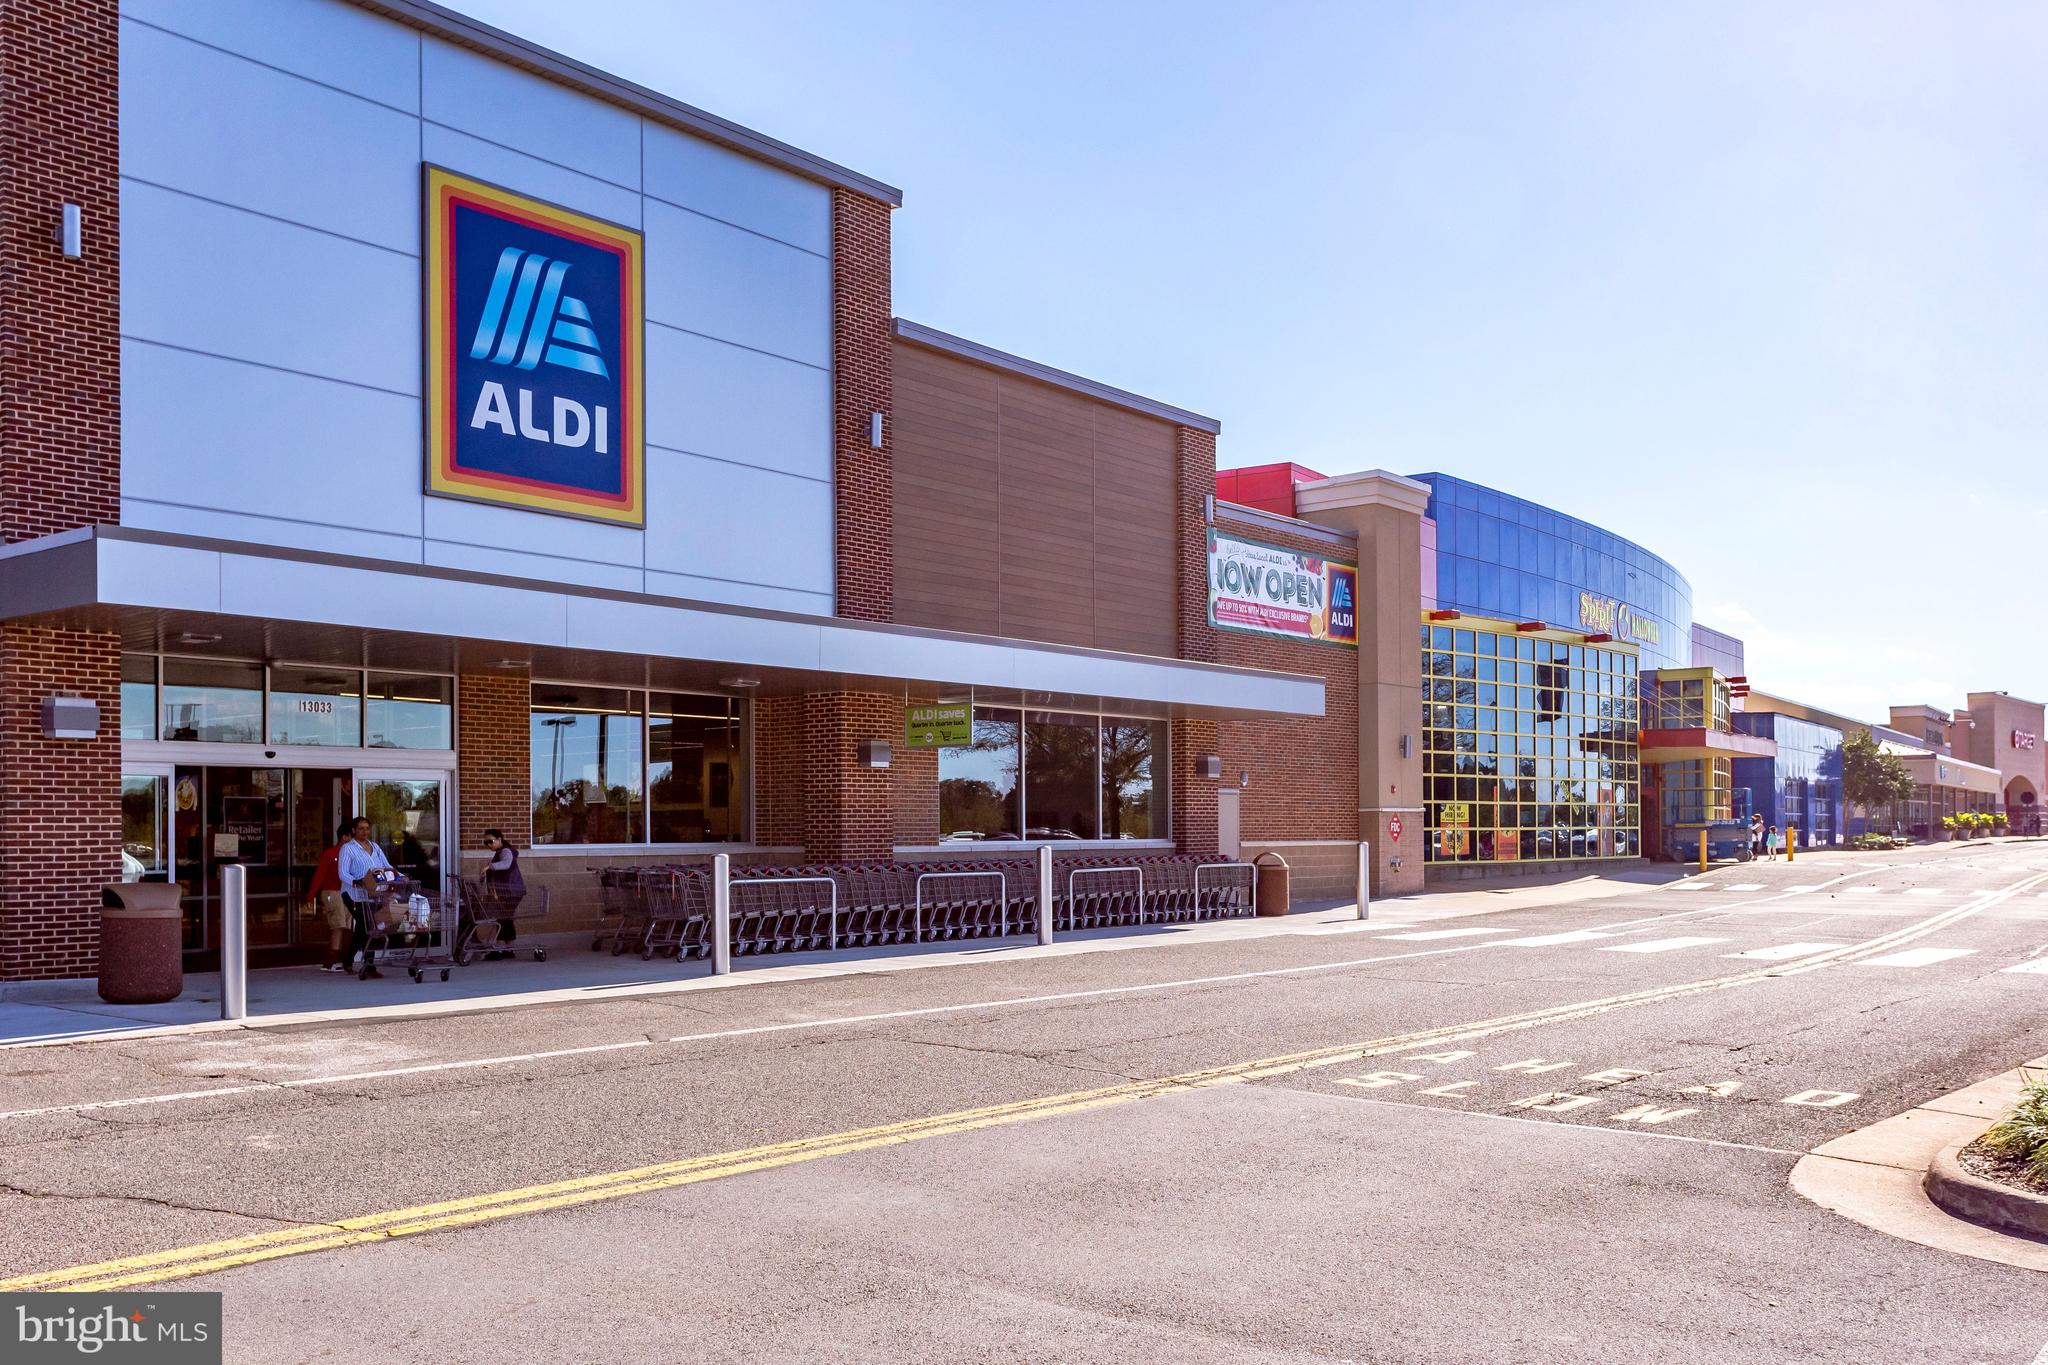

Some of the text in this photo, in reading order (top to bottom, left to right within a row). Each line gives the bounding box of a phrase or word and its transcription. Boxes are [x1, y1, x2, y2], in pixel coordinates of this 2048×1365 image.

[470, 380, 608, 454] ALDI
[1268, 555, 1283, 565] ALDI
[1266, 568, 1322, 609] OPEN
[1331, 611, 1353, 628] ALDI
[302, 701, 332, 713] 13033
[912, 709, 966, 721] ALDI saves
[1444, 811, 1466, 819] HIRNG!
[228, 825, 262, 834] Retailer
[1391, 822, 1401, 832] FDC
[1332, 1071, 1700, 1125] SLOW
